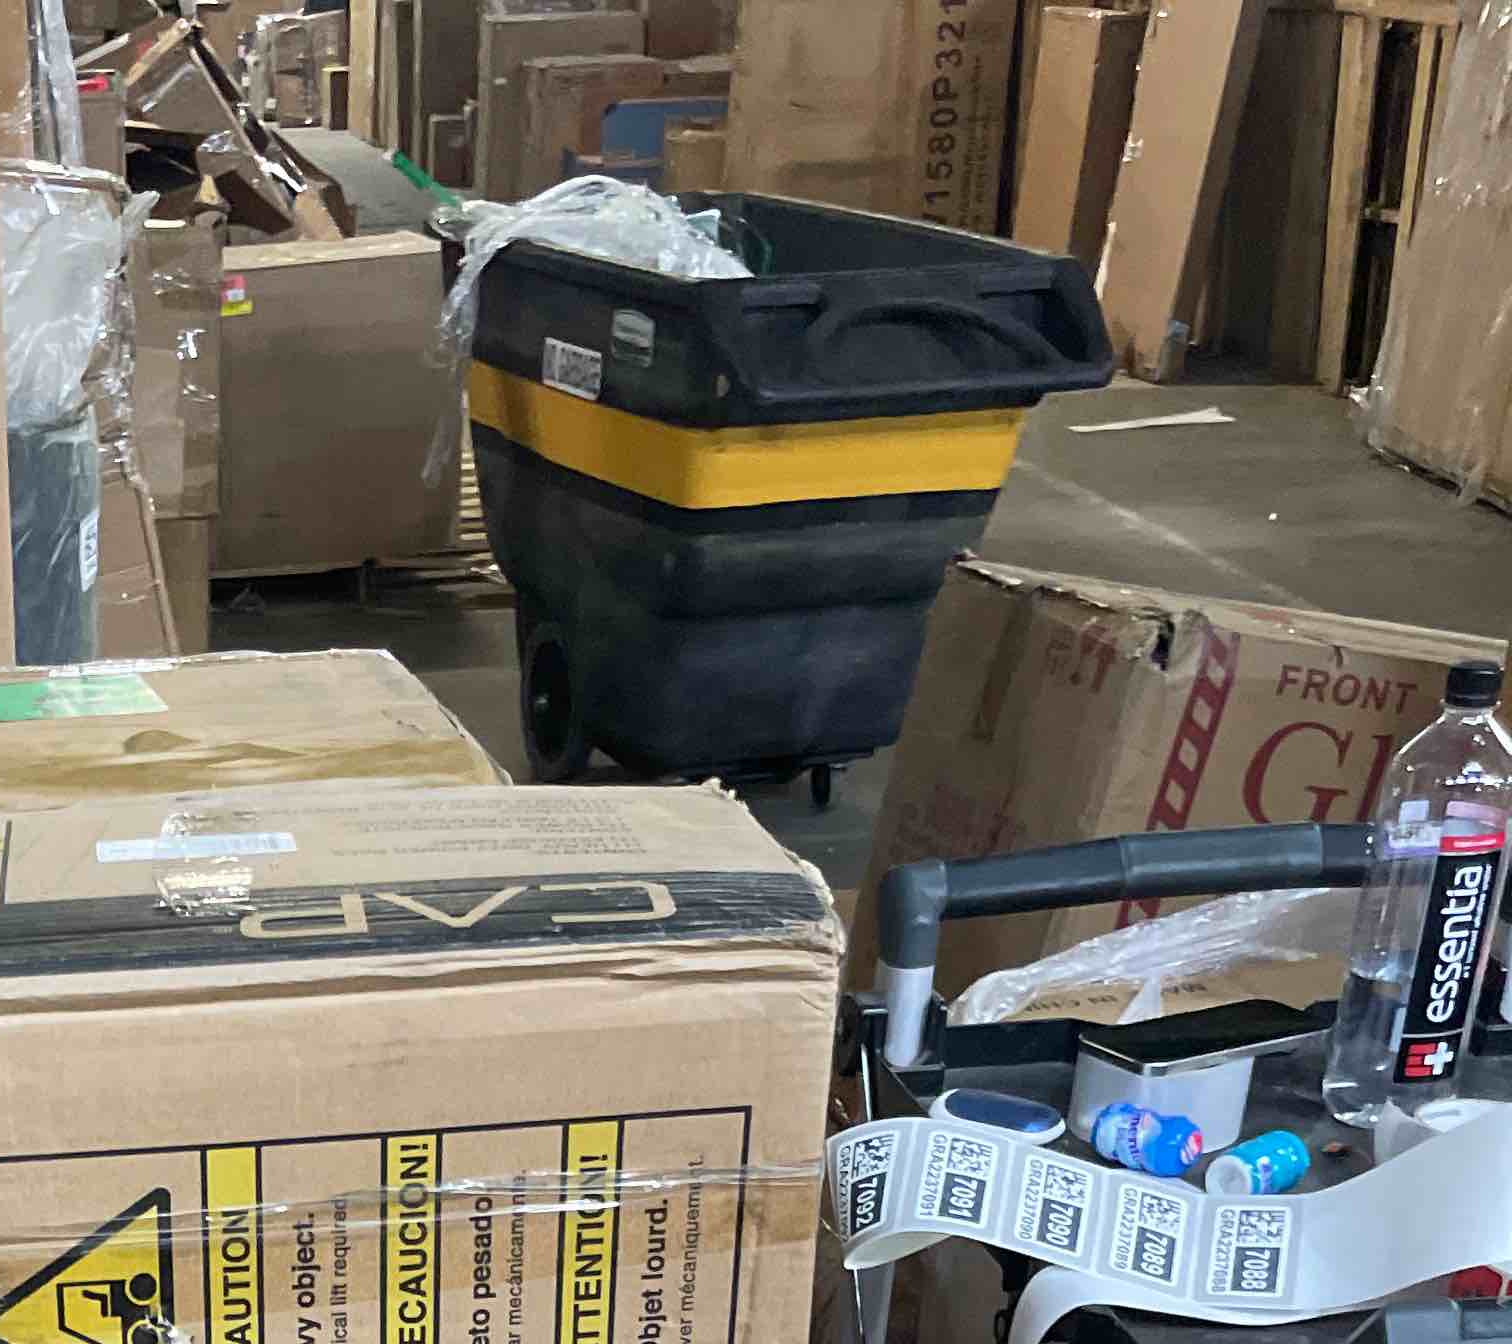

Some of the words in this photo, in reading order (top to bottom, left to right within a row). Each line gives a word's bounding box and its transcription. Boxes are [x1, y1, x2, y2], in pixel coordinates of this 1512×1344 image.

[1275, 664, 1419, 715] FRONT
[1426, 864, 1484, 1023] essentia
[855, 1176, 879, 1230] 7092
[949, 1177, 979, 1219] 7091
[642, 1199, 668, 1280] lourd.
[1045, 1201, 1076, 1247] 7090
[291, 1213, 321, 1308] object.
[1140, 1231, 1169, 1278] 7089
[1240, 1248, 1271, 1291] 7088
[330, 1285, 347, 1308] lift
